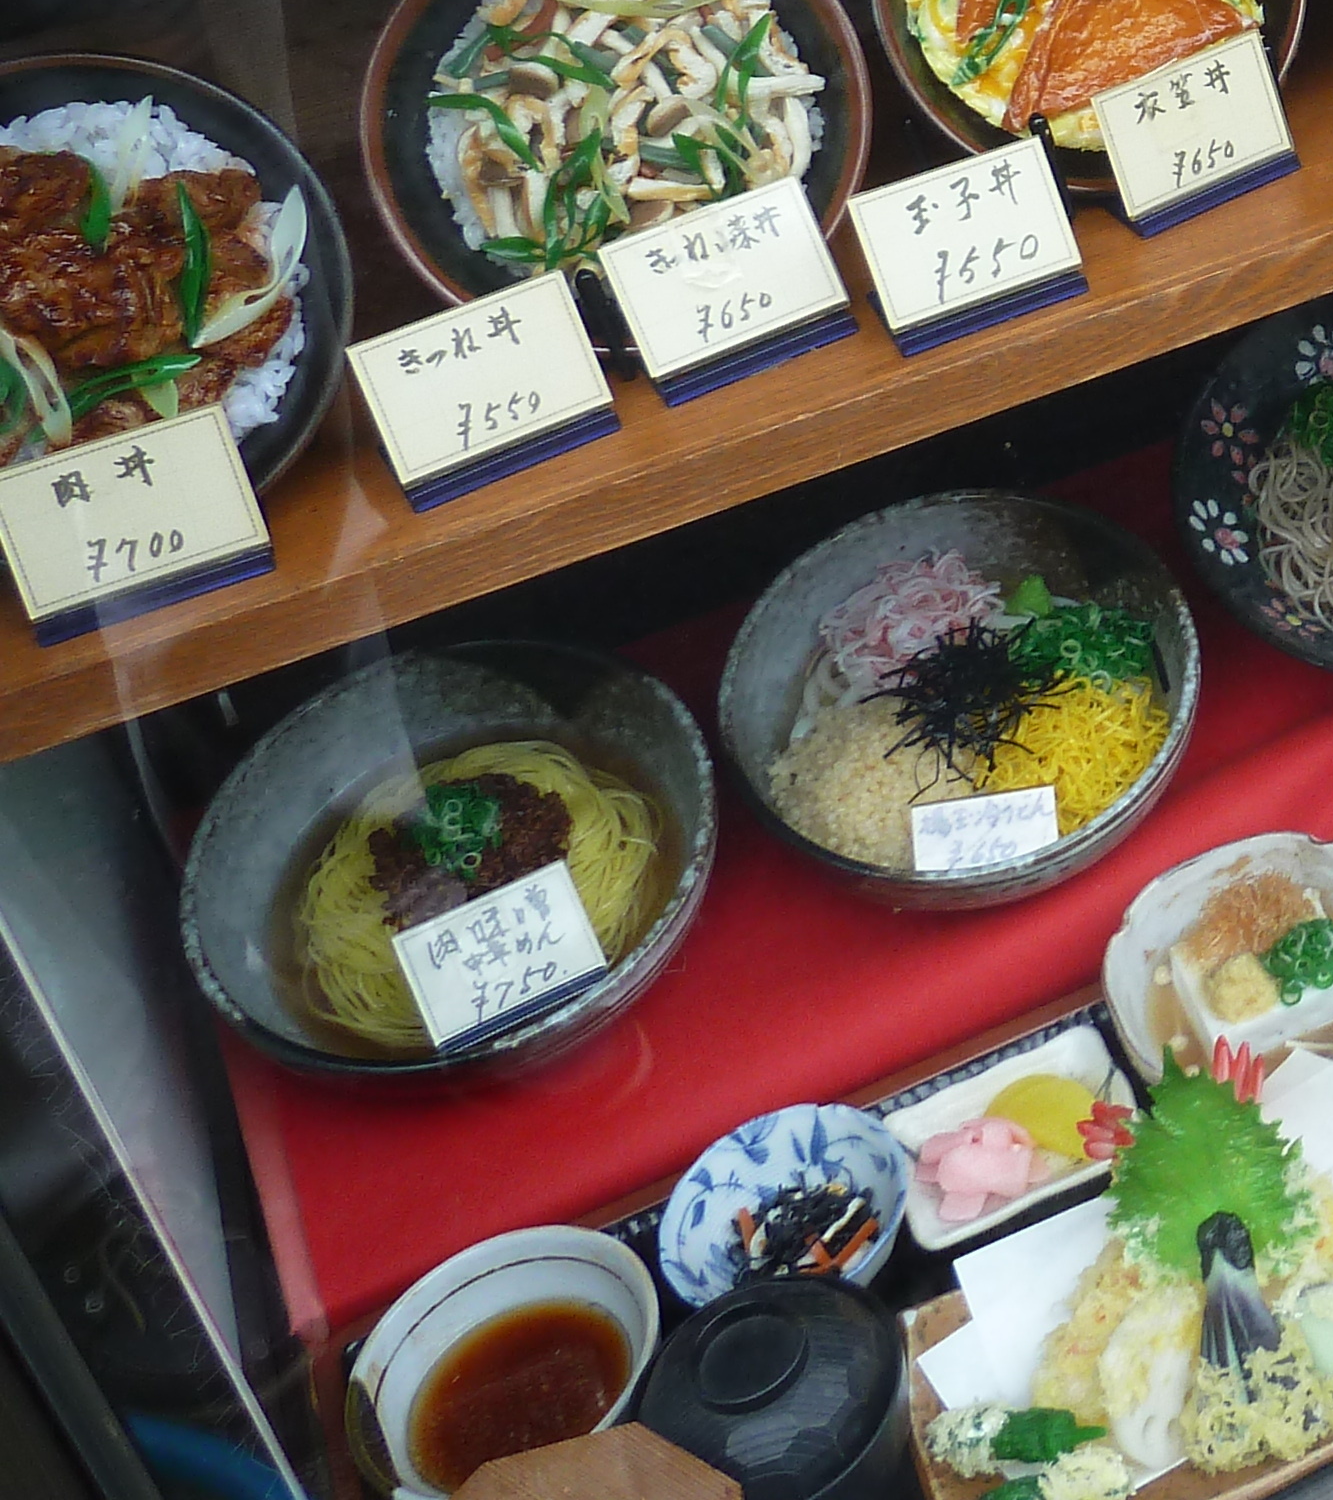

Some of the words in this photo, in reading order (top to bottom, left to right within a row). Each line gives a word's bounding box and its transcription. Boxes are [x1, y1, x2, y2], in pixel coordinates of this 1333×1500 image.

[1172, 139, 1235, 189] ¥650
[905, 158, 1022, 235] 玉子丼
[933, 233, 1039, 303] ¥550
[697, 291, 773, 344] ¥650
[457, 390, 542, 451] ¥550
[87, 530, 184, 582] ¥700
